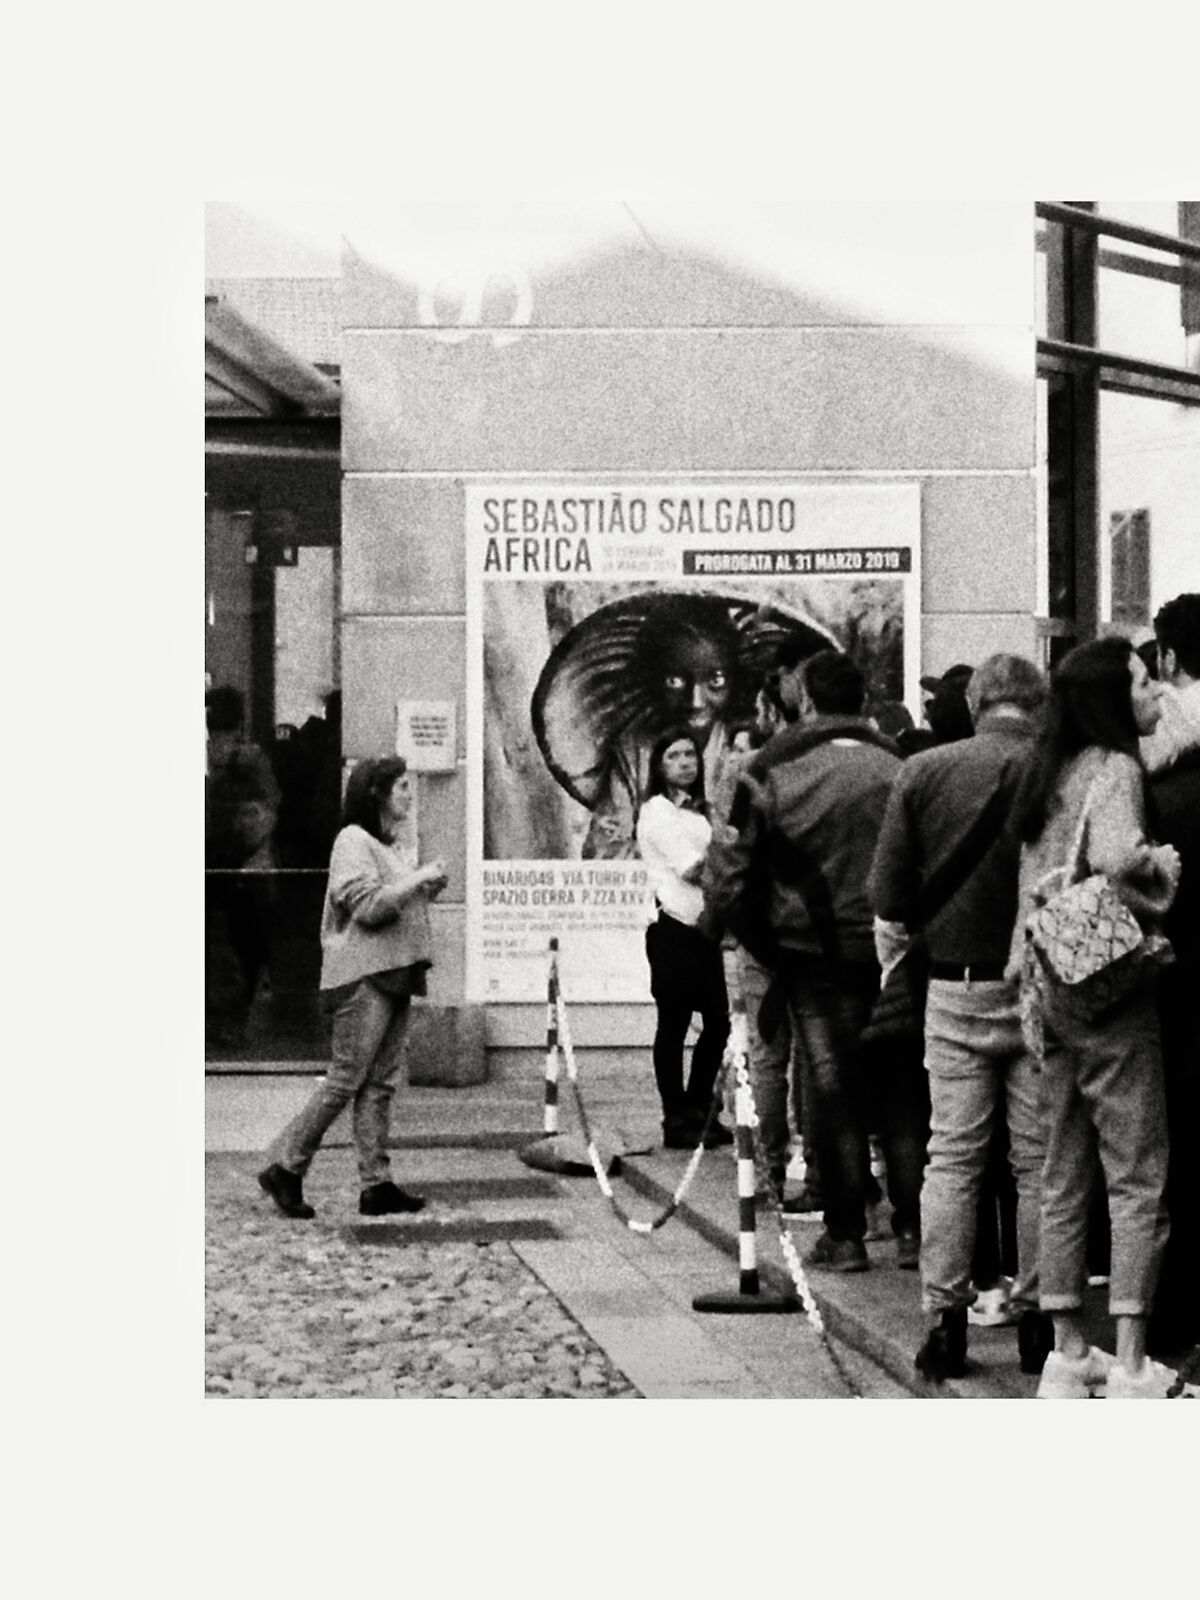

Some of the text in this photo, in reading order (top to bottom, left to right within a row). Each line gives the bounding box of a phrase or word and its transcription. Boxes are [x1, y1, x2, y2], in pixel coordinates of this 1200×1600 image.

[483, 492, 795, 534] SEBASTIÃO SALGADO
[483, 537, 592, 573] AFRICA
[694, 551, 900, 571] PROROGATA AL 31 MARZO 2019
[562, 870, 584, 886] VIA
[631, 870, 648, 886] 49
[482, 888, 528, 906] SPAZIO
[532, 888, 575, 906] GERRA
